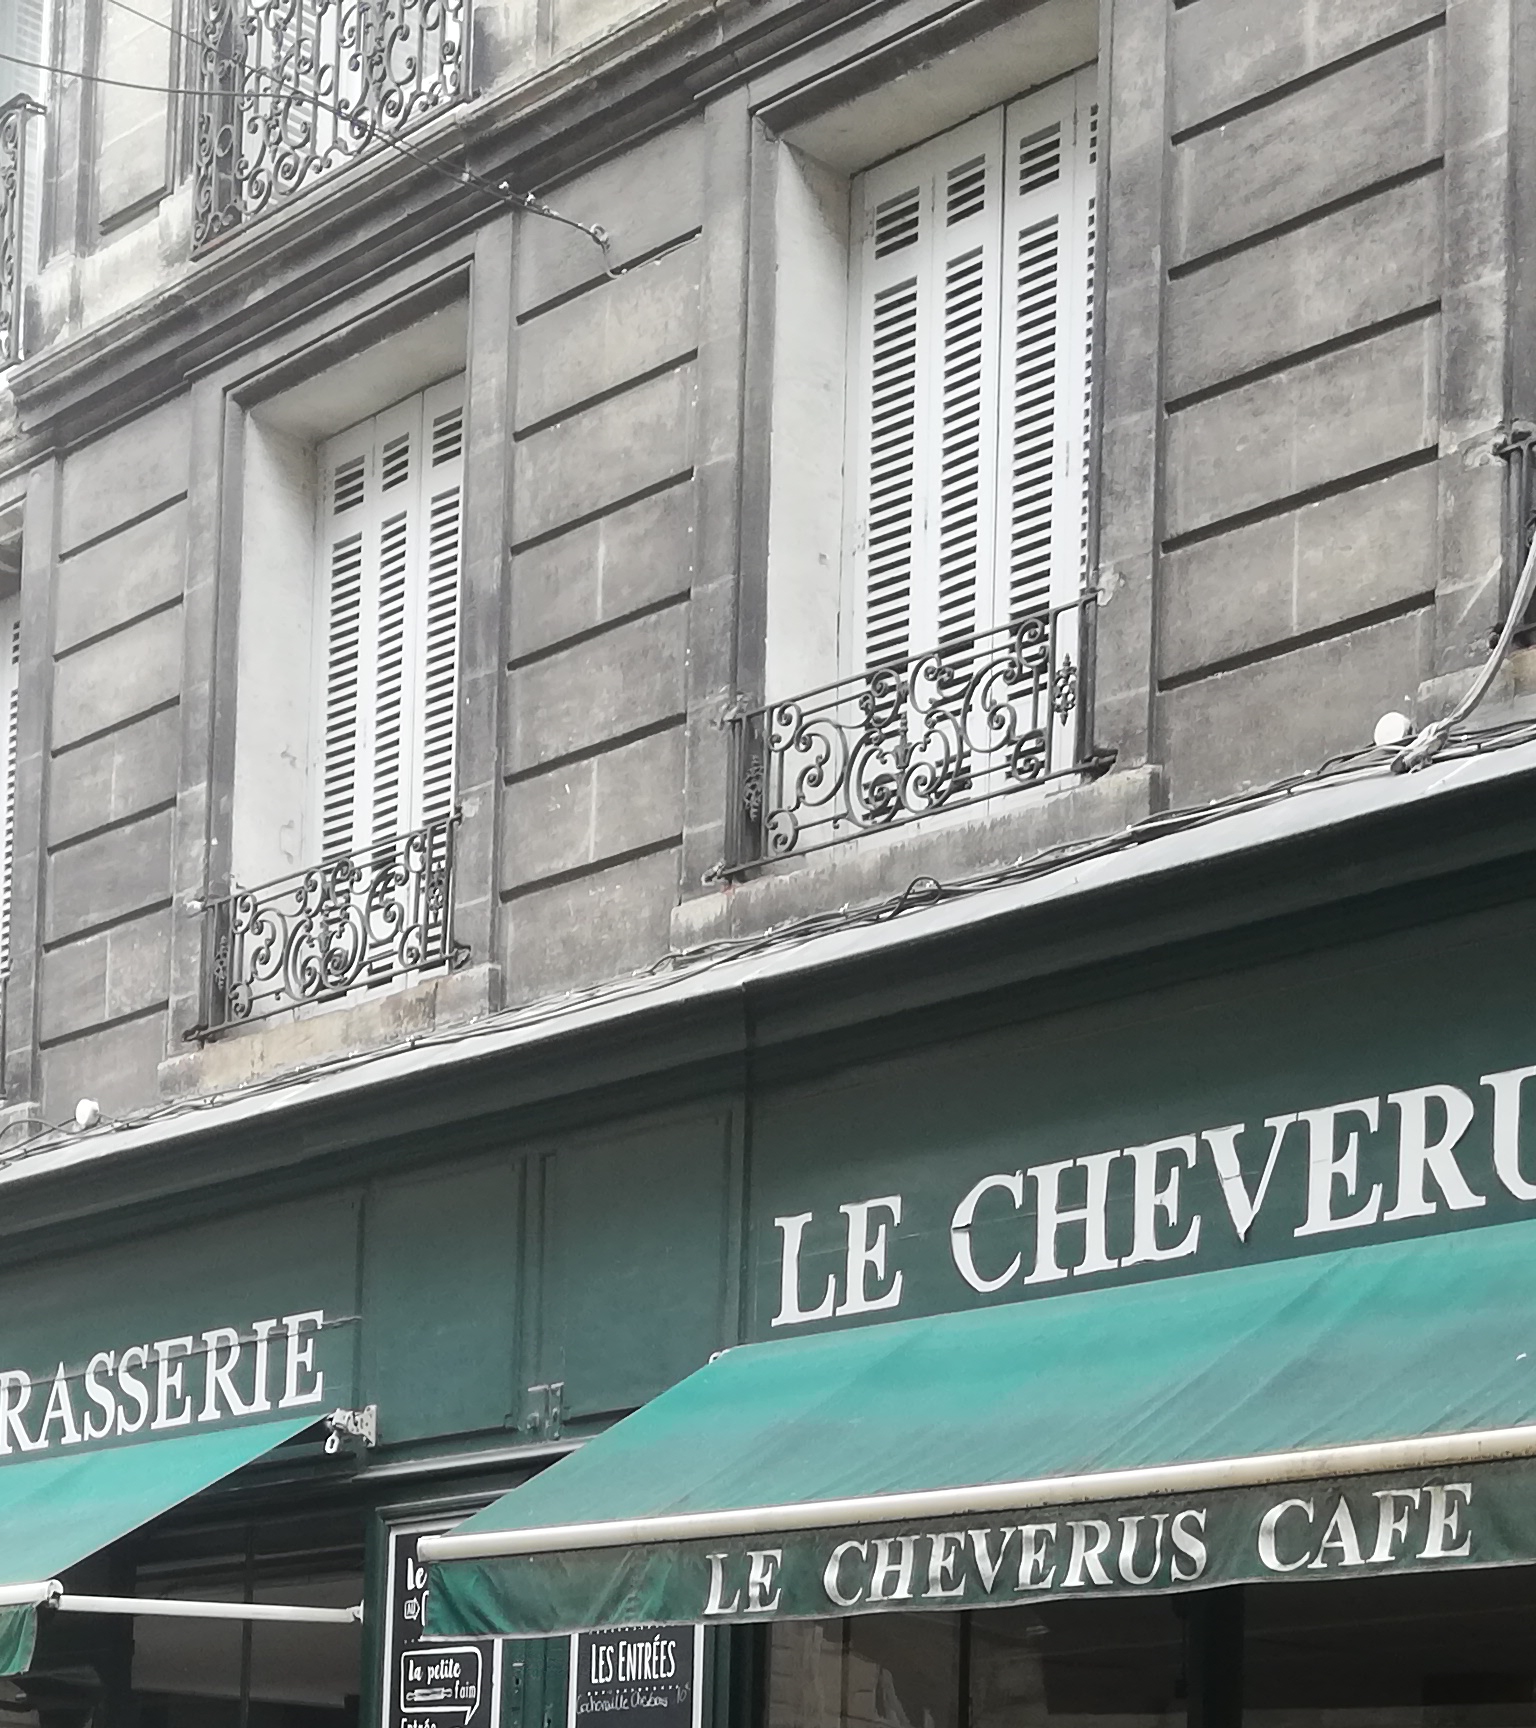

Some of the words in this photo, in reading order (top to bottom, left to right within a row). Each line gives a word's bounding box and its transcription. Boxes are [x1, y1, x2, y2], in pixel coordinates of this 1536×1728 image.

[770, 1196, 904, 1328] LE
[702, 1547, 783, 1616] LE
[823, 1509, 1210, 1607] CHEVERUS
[1257, 1482, 1474, 1573] CAFE
[427, 1658, 461, 1685] petite
[591, 1643, 614, 1684] LES
[454, 1680, 476, 1699] faim
